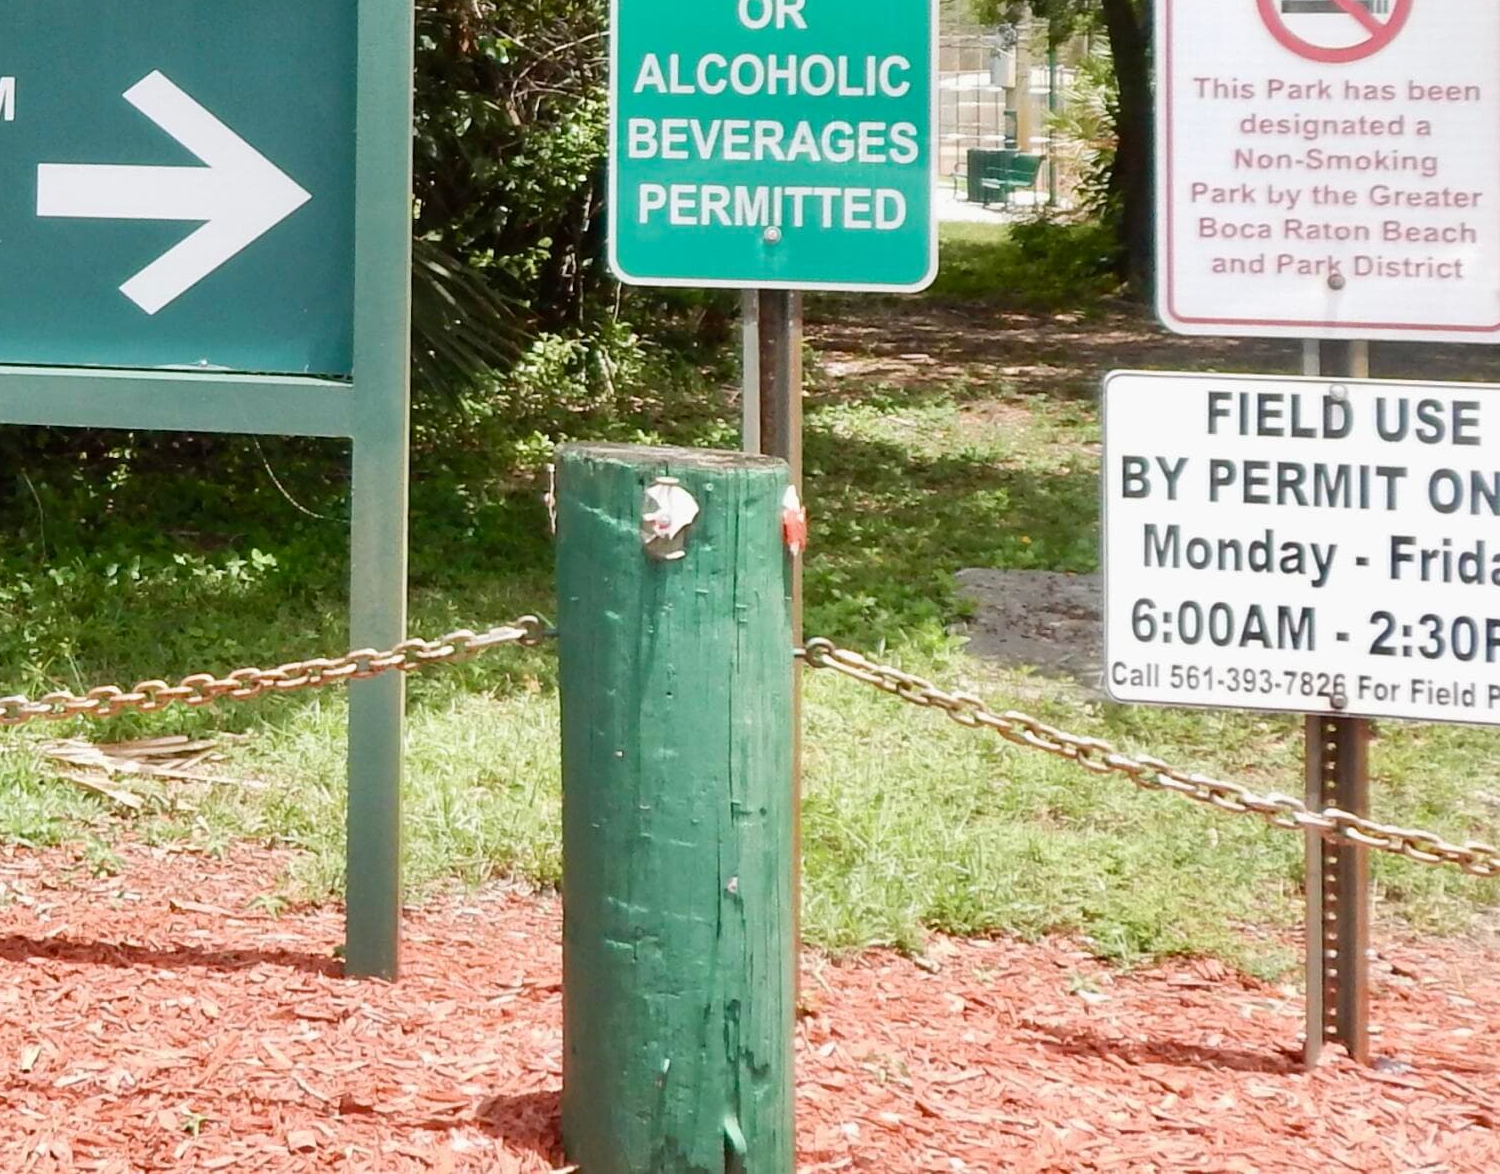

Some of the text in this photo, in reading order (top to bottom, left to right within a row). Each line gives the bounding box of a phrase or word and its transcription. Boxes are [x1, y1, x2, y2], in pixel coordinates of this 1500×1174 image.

[633, 53, 910, 97] ALCOHOLIC
[1194, 78, 1481, 101] This Park has been
[628, 118, 918, 164] BEVERAGES
[1240, 114, 1431, 140] designated a
[1234, 149, 1438, 176] Non-Smoking
[638, 184, 906, 230] PERMITTED
[1191, 183, 1482, 210] Park by the Greater
[1199, 218, 1476, 243] Boca Raton Beach
[1212, 254, 1463, 278] and Park District
[1207, 391, 1481, 446] FIELD USE
[1122, 455, 1188, 500] BY
[1209, 458, 1407, 510] PERMIT
[1143, 523, 1338, 588] Monday
[1356, 557, 1369, 566] -
[1132, 598, 1316, 651] 6:00AM
[1336, 631, 1349, 641] -
[1112, 661, 1160, 687] Call
[1170, 664, 1346, 697] 561-393-7826
[1358, 675, 1400, 701] For
[1411, 679, 1475, 707] Field
